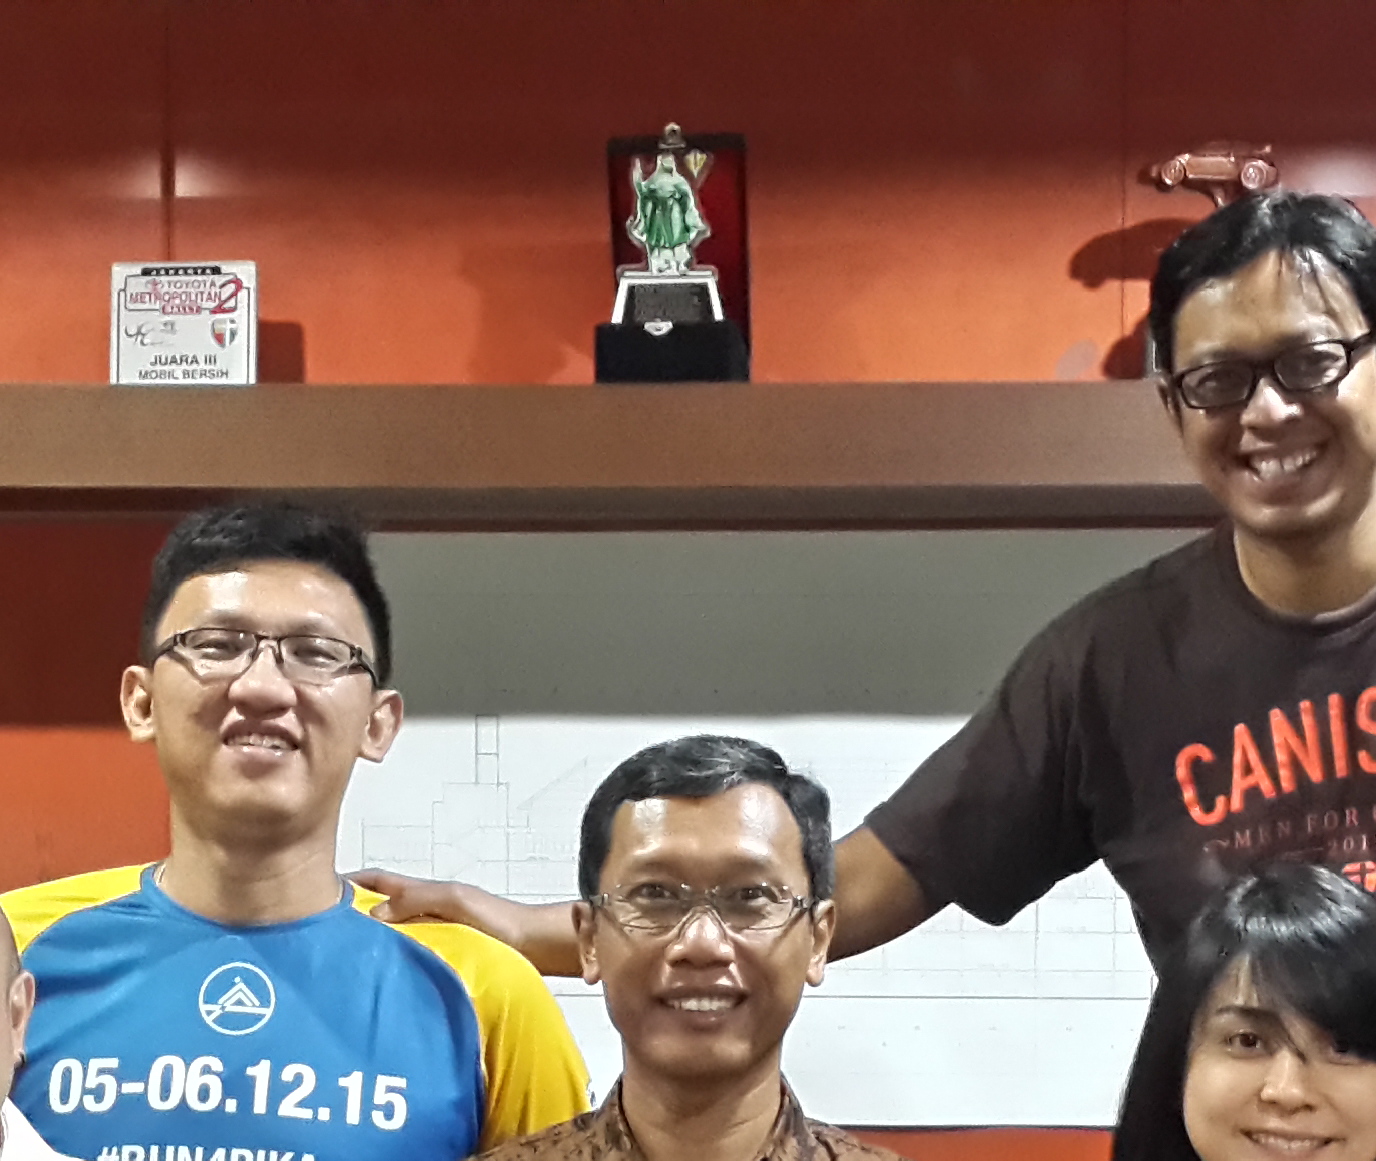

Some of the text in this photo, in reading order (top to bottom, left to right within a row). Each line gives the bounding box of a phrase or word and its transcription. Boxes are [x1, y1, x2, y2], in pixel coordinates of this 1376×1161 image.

[129, 278, 243, 315] METROPOLITAN 2
[166, 279, 217, 290] TOYOTA
[150, 353, 218, 367] JUARA III
[138, 368, 229, 381] MOBIL BERSIH
[1233, 820, 1292, 849] MEN
[1307, 806, 1359, 834] FOR
[48, 1055, 408, 1131] 05-06.12.15
